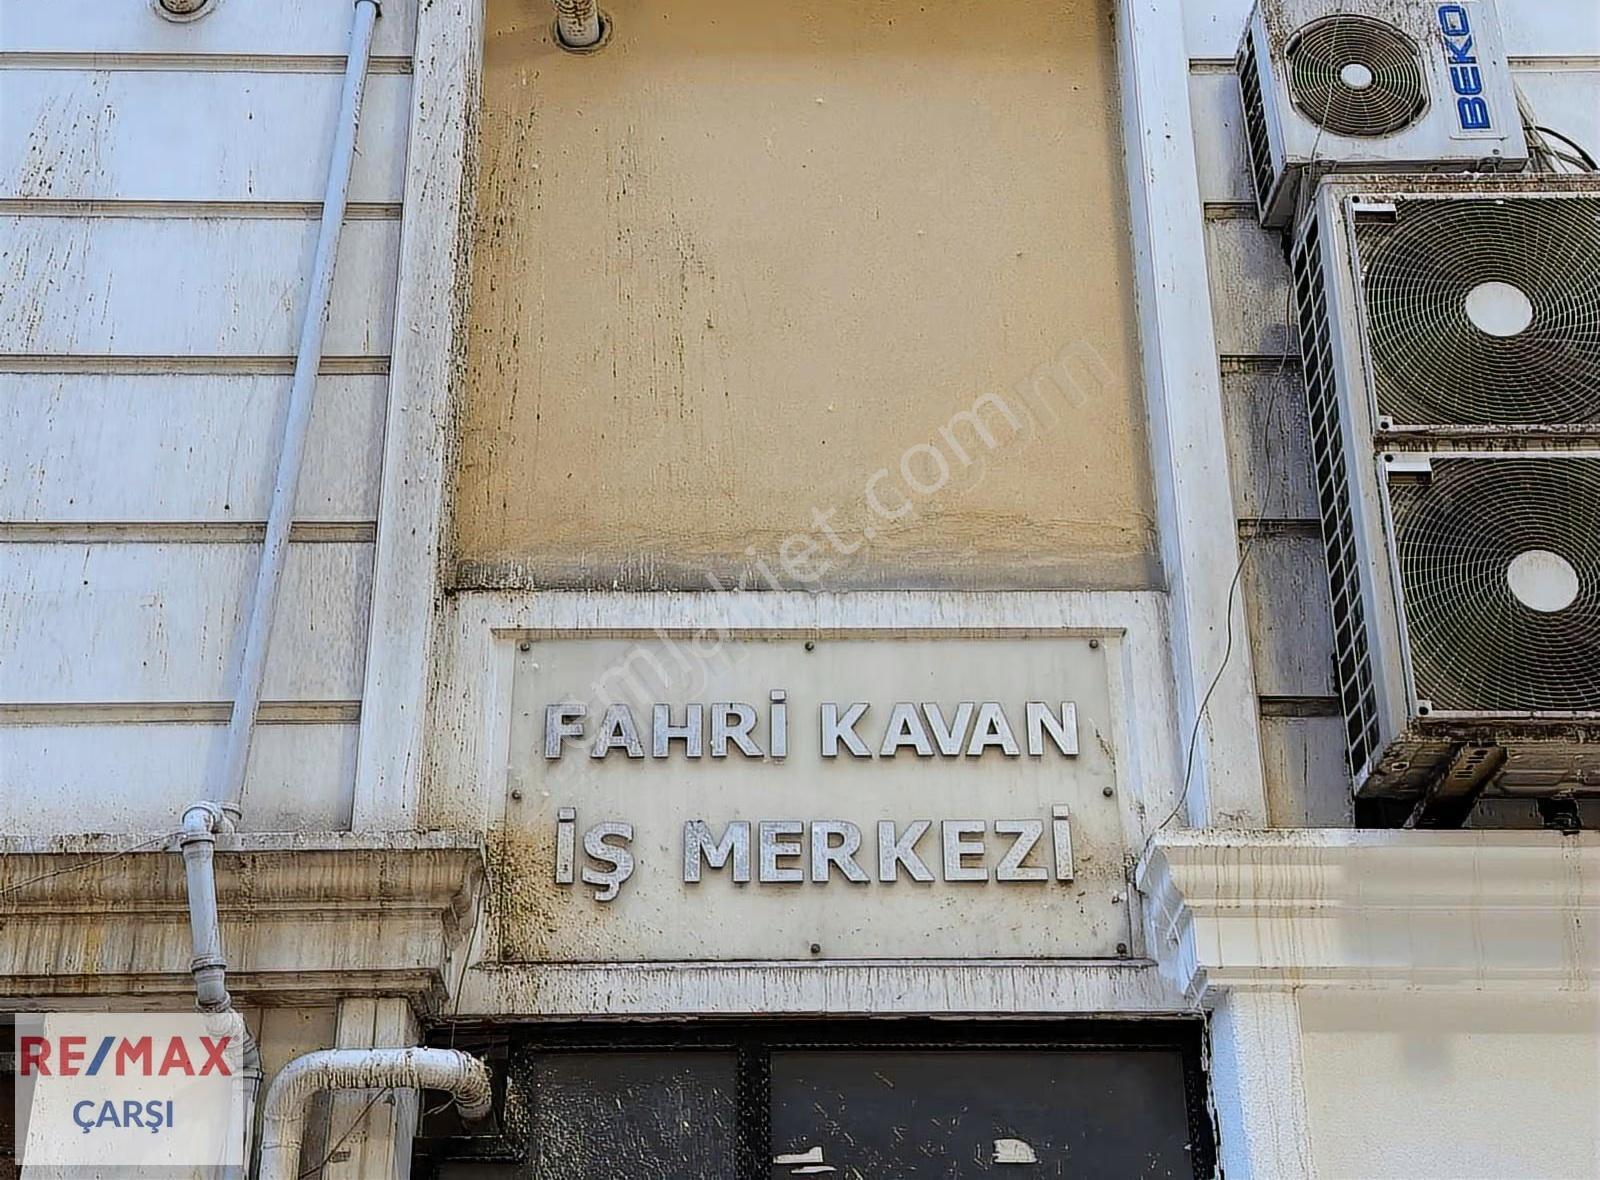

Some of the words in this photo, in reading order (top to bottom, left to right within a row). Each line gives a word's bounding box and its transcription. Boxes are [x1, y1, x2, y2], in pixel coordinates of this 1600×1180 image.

[1438, 5, 1491, 129] BEKO
[544, 688, 789, 760] FAHRİ
[819, 701, 1080, 759] KAVAN
[554, 806, 635, 901] İŞ
[683, 803, 1075, 885] MERKEZİ
